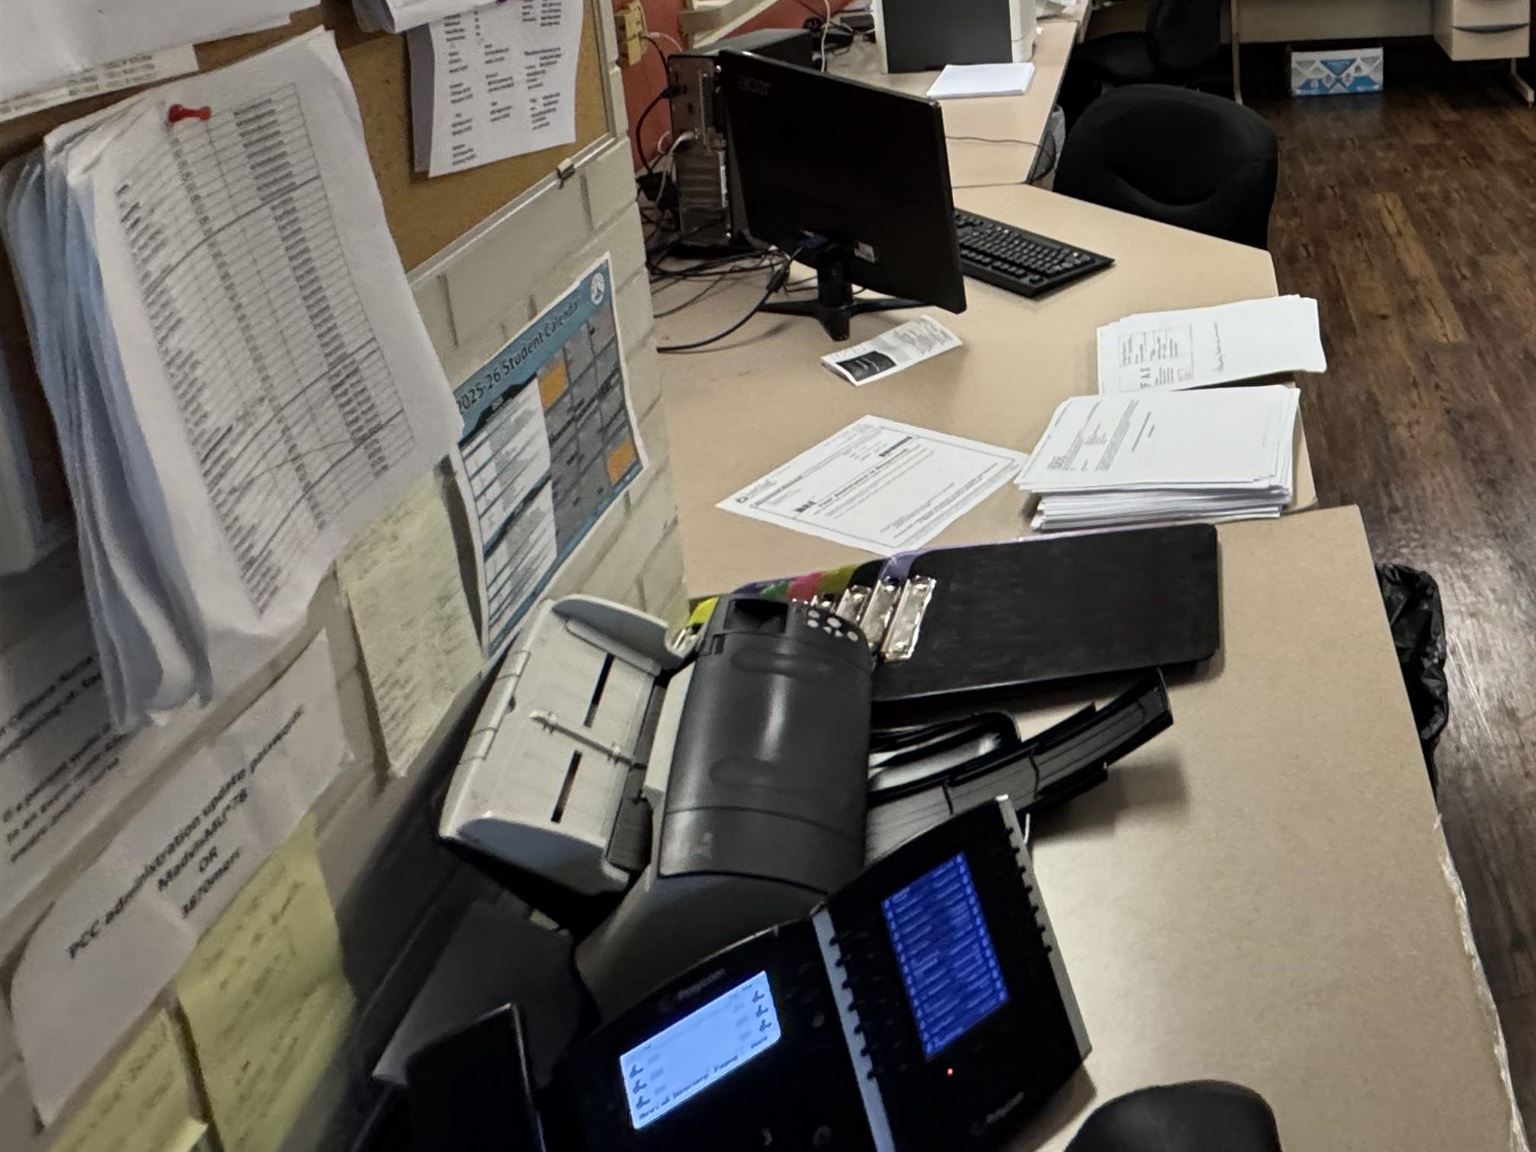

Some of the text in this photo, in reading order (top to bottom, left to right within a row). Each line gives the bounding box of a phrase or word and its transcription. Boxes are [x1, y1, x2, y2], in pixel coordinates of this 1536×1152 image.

[457, 299, 580, 414] 2025-26 Student Calendar
[67, 919, 101, 959] PCC
[105, 815, 201, 925] administration
[203, 768, 246, 818] update
[199, 846, 219, 873] OR
